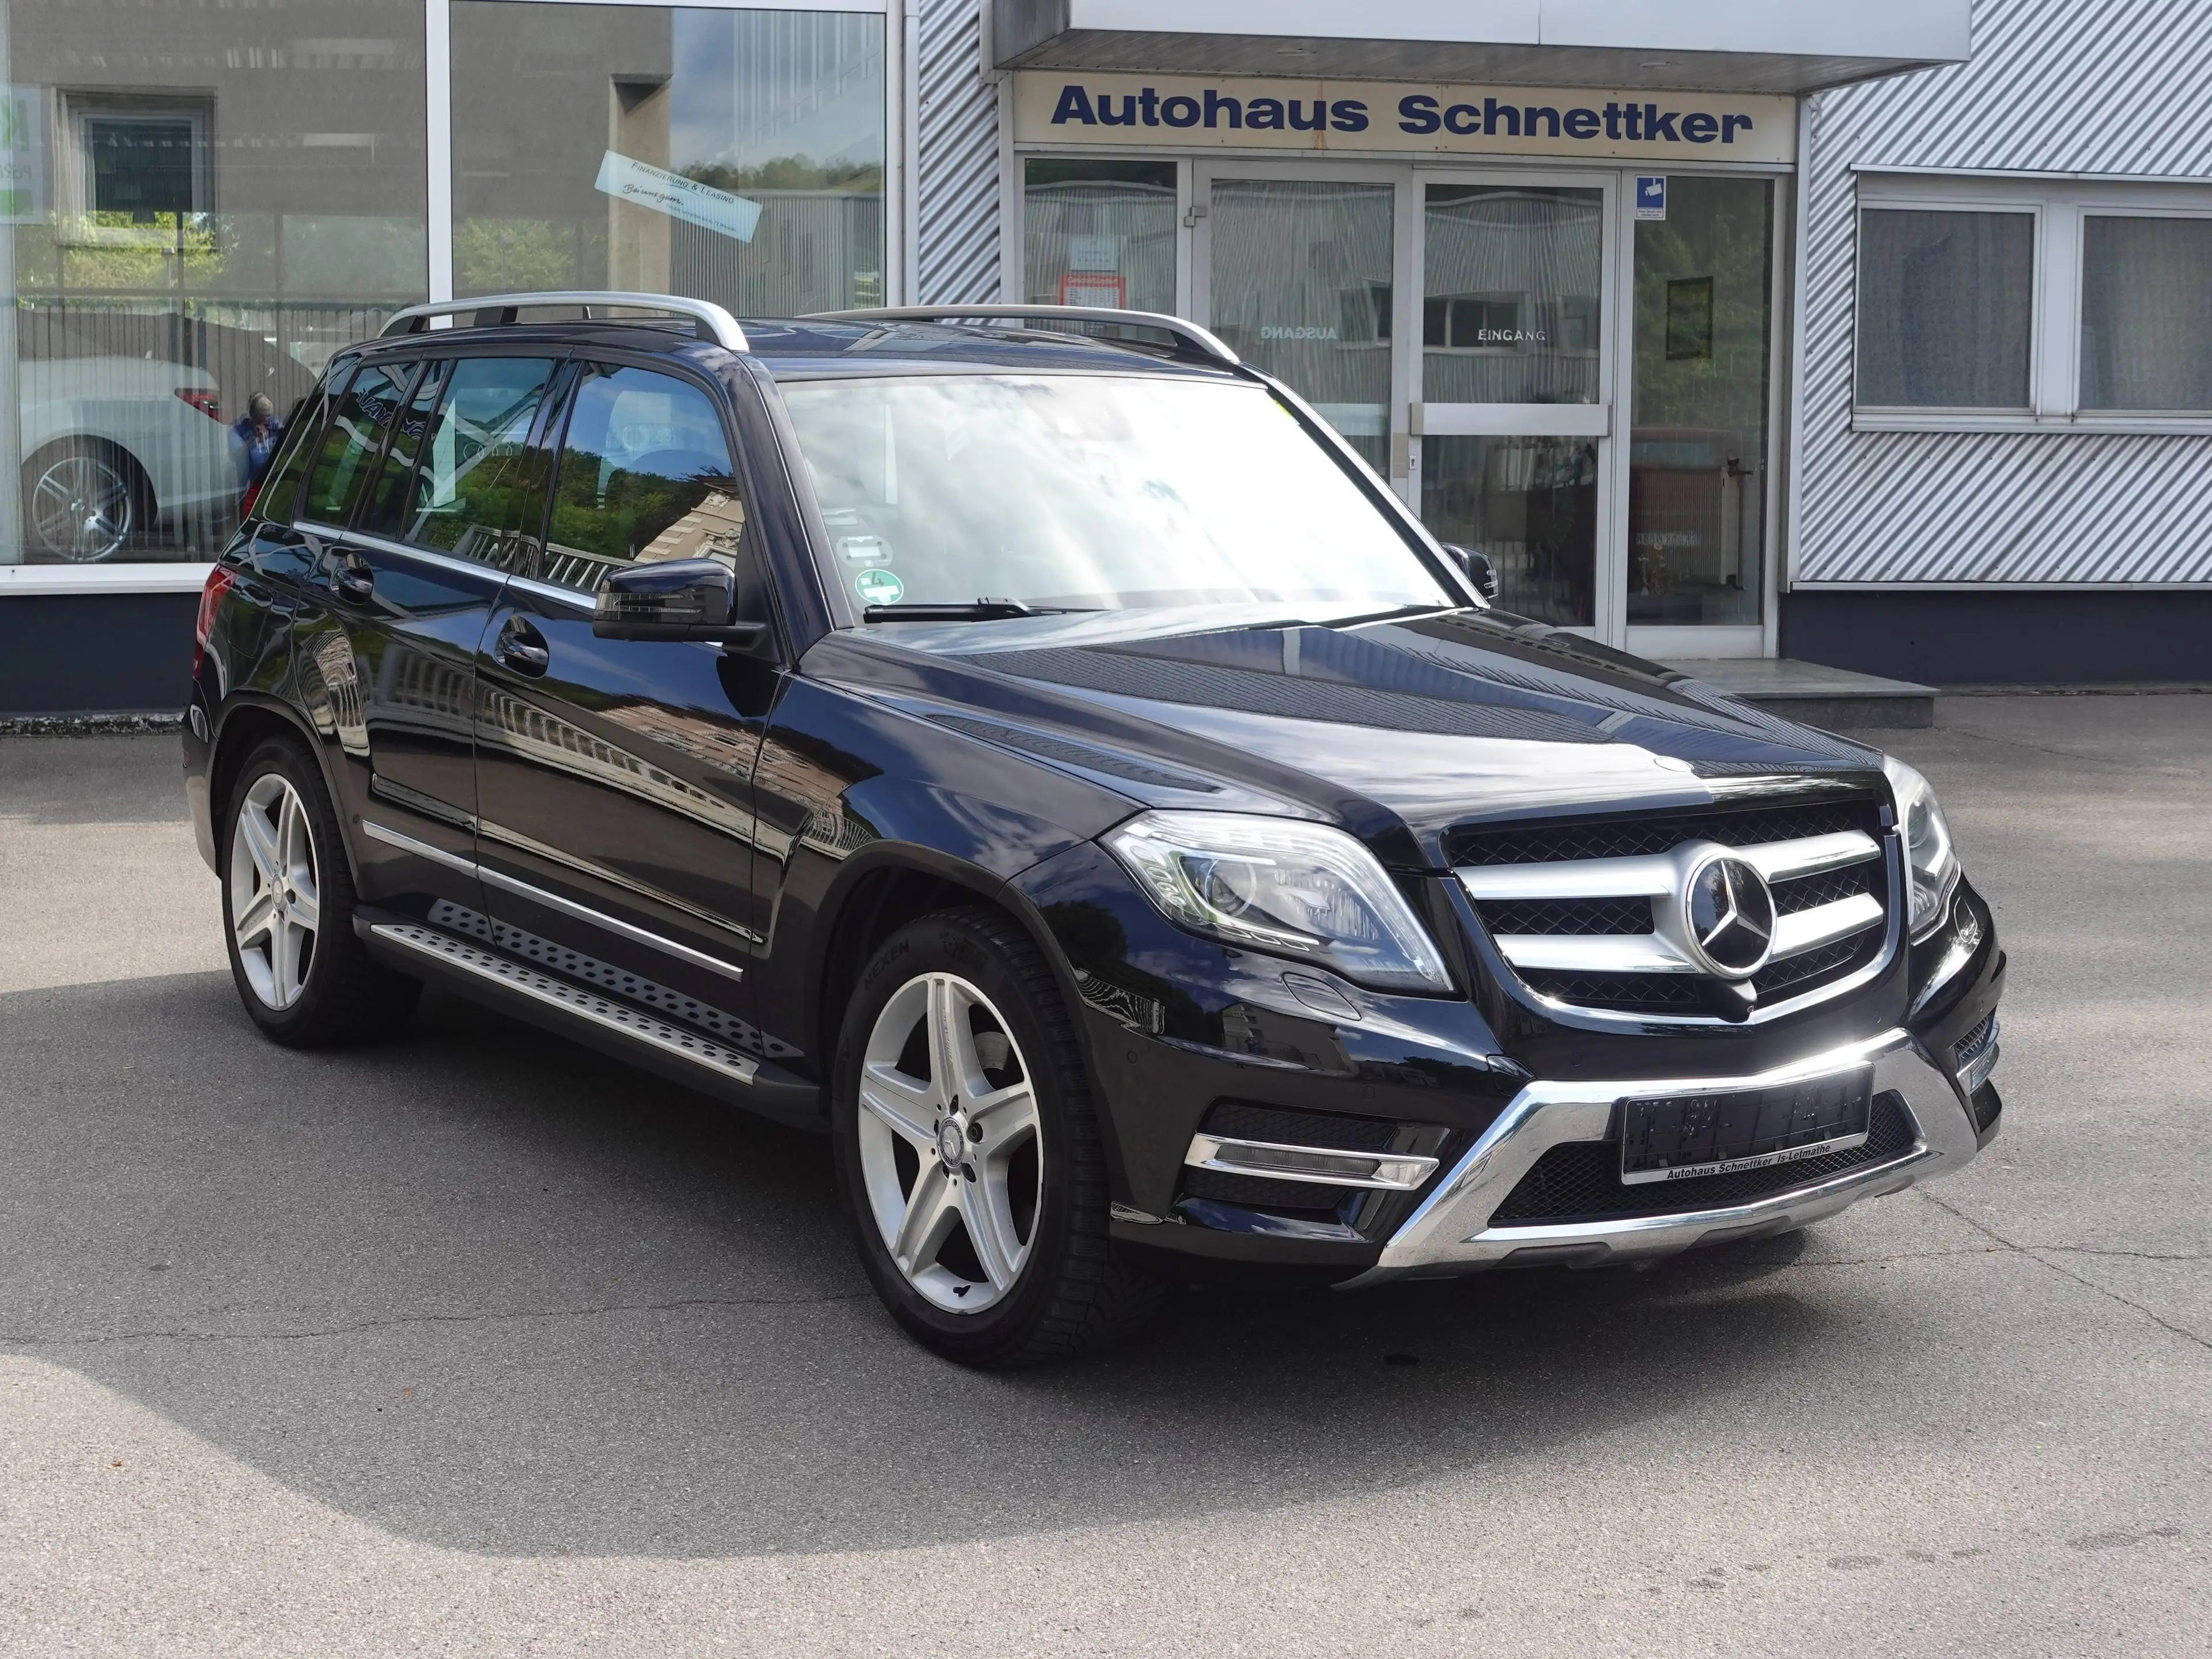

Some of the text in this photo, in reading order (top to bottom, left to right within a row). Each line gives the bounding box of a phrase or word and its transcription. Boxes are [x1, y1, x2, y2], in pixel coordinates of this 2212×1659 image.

[1051, 85, 1753, 143] Autohaus Schnettker
[632, 161, 689, 188] FINANZIERUNG
[691, 184, 698, 192] &
[1478, 329, 1546, 341] EINGANG
[871, 571, 884, 586] 4
[864, 938, 910, 993] NEXEN
[1667, 1144, 1831, 1180] Autohaus Schnettker Is-Letmathe
